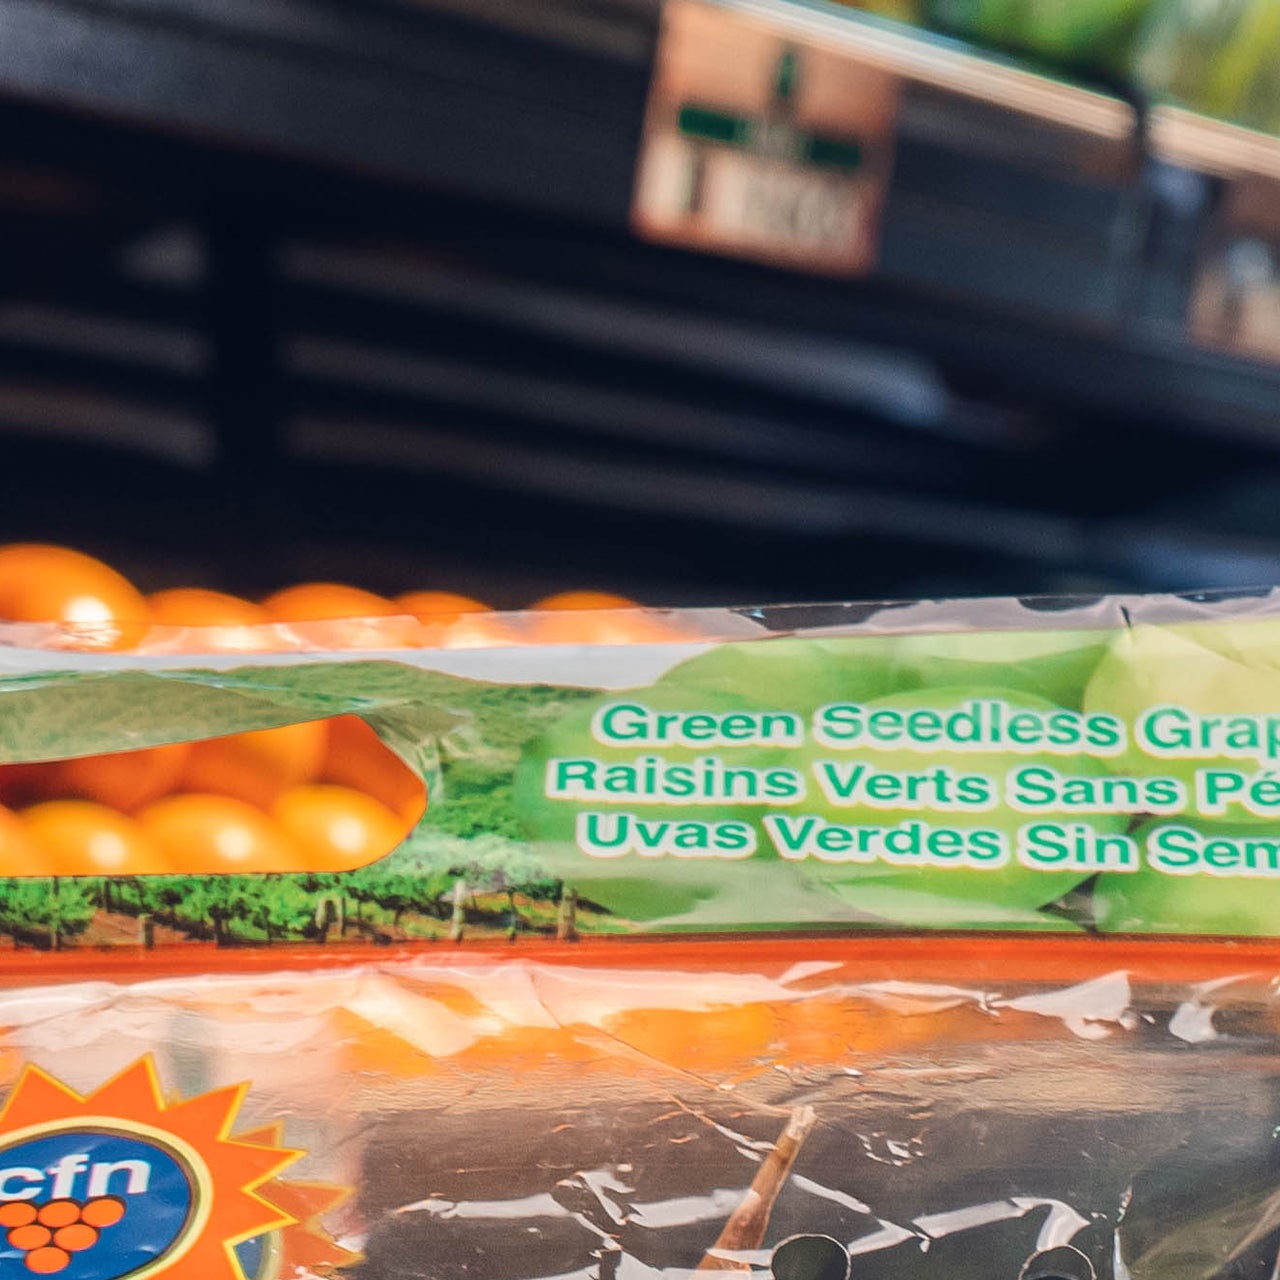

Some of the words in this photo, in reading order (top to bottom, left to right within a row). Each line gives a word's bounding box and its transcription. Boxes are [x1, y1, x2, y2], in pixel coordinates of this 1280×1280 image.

[600, 704, 799, 741] Green
[821, 703, 1121, 748] Seedless
[556, 760, 799, 798] Raisins
[822, 764, 990, 806] Verts
[1014, 766, 1180, 808] Sans
[585, 813, 751, 853] Uvas
[775, 816, 1001, 862] Verdes
[1027, 822, 1132, 867] Sin
